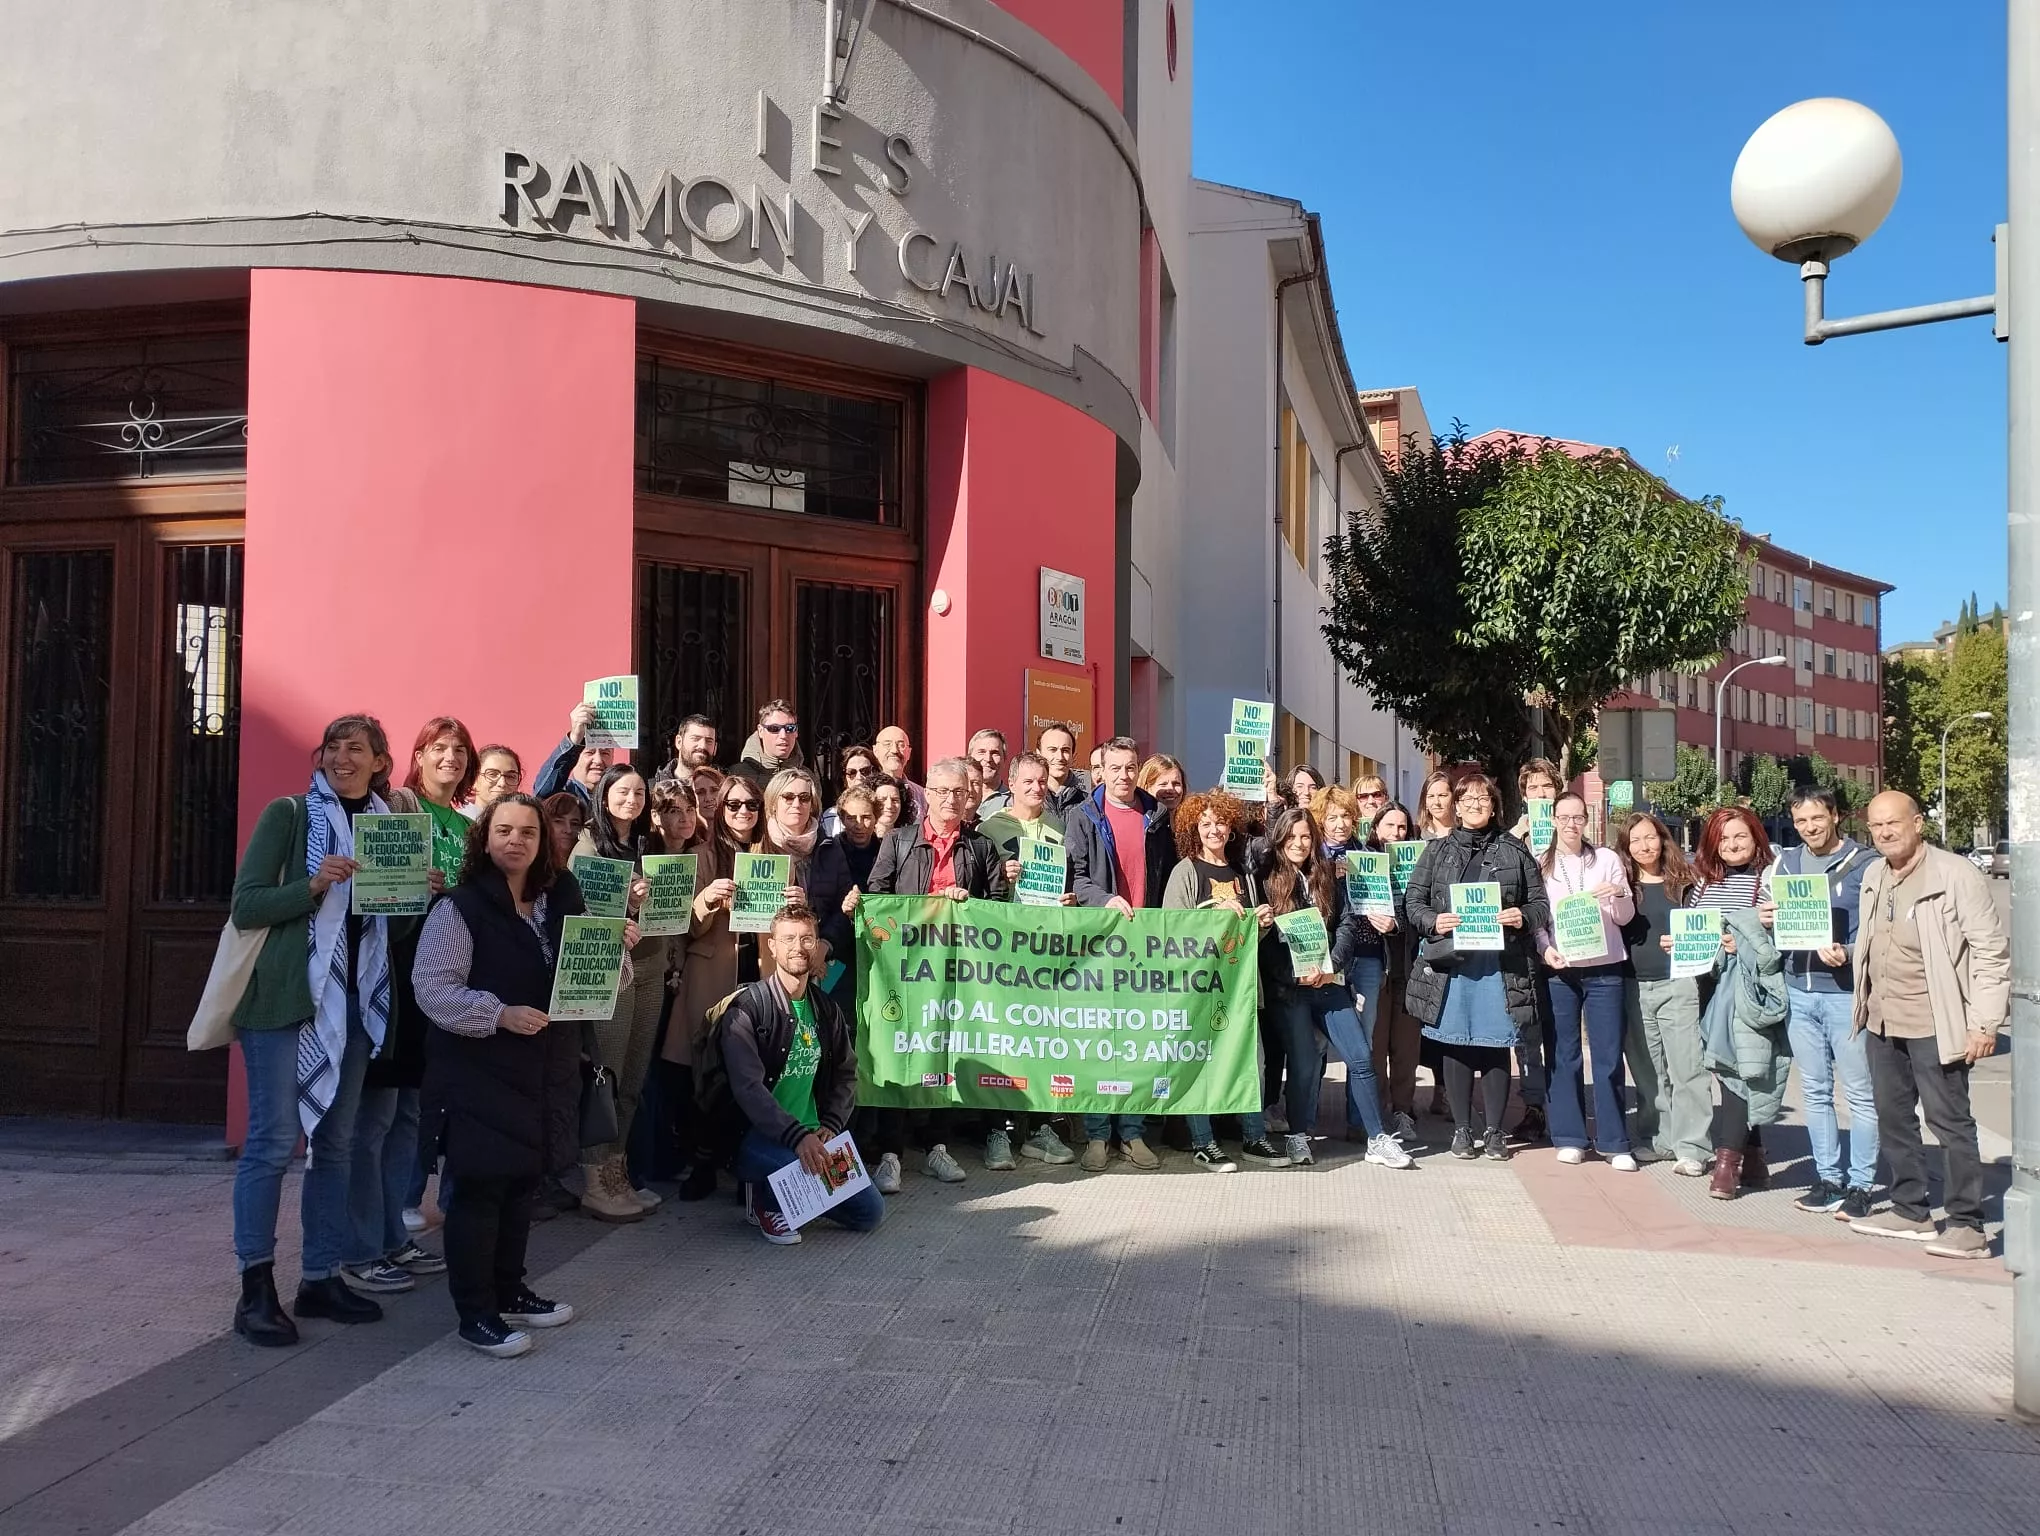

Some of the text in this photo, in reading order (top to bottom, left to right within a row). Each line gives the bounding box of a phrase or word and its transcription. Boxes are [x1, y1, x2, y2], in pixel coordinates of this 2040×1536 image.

[758, 89, 914, 196] IES
[499, 150, 1046, 337] RAMON Y CAJAL
[600, 682, 622, 698] NO!
[597, 700, 635, 709] CONCIERTO
[627, 711, 636, 720] EN
[1244, 705, 1261, 720] NO!
[1238, 740, 1256, 756] NO!
[1229, 766, 1258, 775] EDUCATIVO
[378, 820, 409, 831] DINERO
[401, 832, 423, 842] PARA
[363, 844, 374, 855] LA
[1034, 845, 1053, 862] NO!
[1397, 846, 1416, 862] NO!
[590, 861, 615, 872] DINERO
[658, 863, 684, 874] DINERO
[751, 859, 775, 879] NO!
[1031, 862, 1064, 875] CONCIERTO
[1359, 857, 1377, 873] NO!
[607, 873, 624, 884] PARA
[676, 874, 694, 885] PARA
[1021, 870, 1063, 884] EDUCATIVO EN
[736, 881, 786, 892] AL CONCIERTO
[1018, 880, 1063, 894] BACHILLERATO
[1787, 880, 1812, 898] NO!
[736, 891, 774, 902] EDUCATIVO
[1465, 887, 1486, 904] NO!
[1456, 905, 1499, 914] AL CONCIERTO
[1787, 900, 1828, 909] CONCIERTO
[1777, 911, 1828, 920] EDUCATIVO EN
[1685, 914, 1707, 931] NO!
[1776, 921, 1829, 930] BACHILLERATO
[580, 928, 611, 940] DINERO
[1675, 933, 1720, 942] AL CONCIERTO
[563, 939, 622, 956] PÚBLICO PARA
[901, 923, 1220, 962] DINERO PÚBLICO, PARA
[1675, 942, 1719, 952] EDUCATIVO EN
[561, 957, 571, 969] LA
[901, 958, 1224, 994] LA EDUCACIÓN PÚBLICA
[921, 999, 1192, 1031] ¡NO AL CONCIERTO DEL
[894, 1031, 1213, 1062] BACHILLERATO Y 0-3 AÑOS!
[981, 1076, 1012, 1086] CCOO
